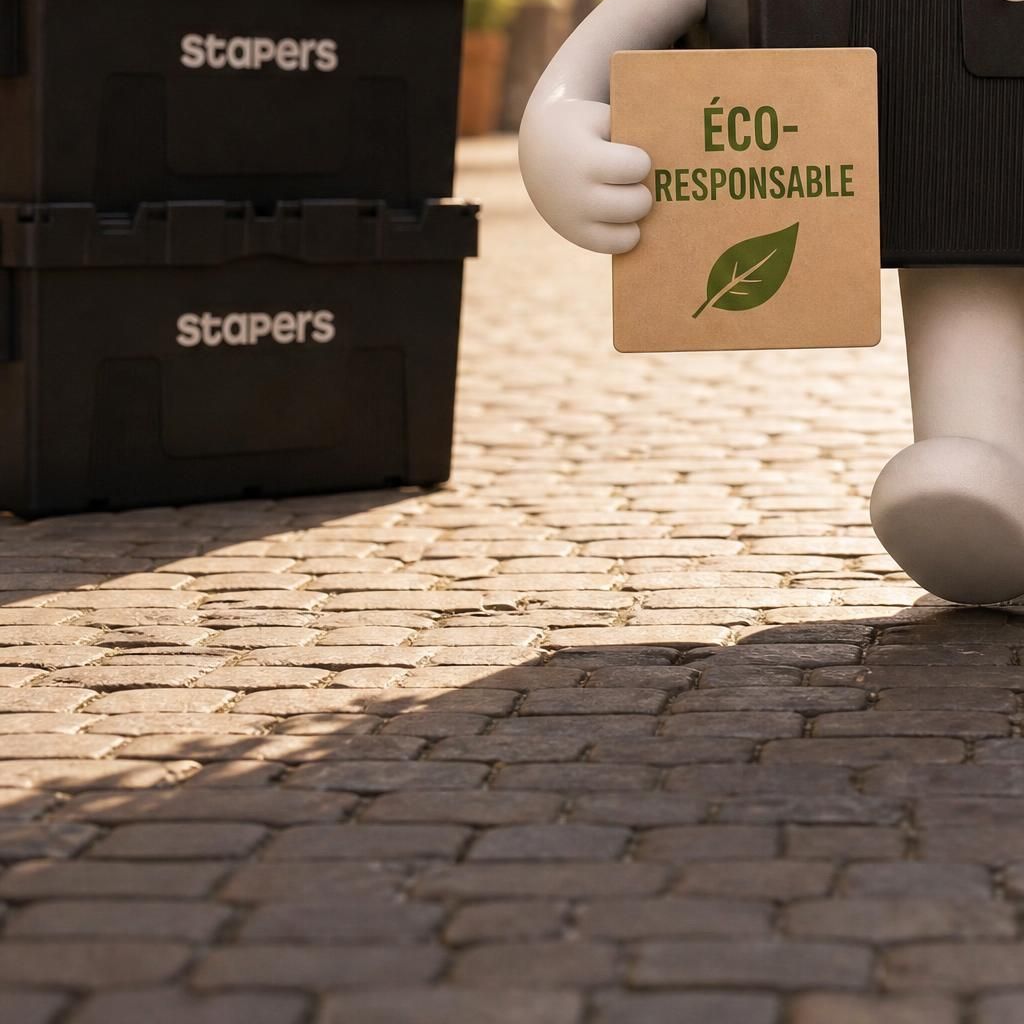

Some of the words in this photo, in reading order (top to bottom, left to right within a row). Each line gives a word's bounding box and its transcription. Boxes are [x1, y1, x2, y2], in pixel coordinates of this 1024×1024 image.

[180, 33, 338, 72] stapers
[703, 96, 799, 153] ÉCO-
[654, 164, 855, 202] RESPONSABLE
[176, 309, 336, 347] stapers
